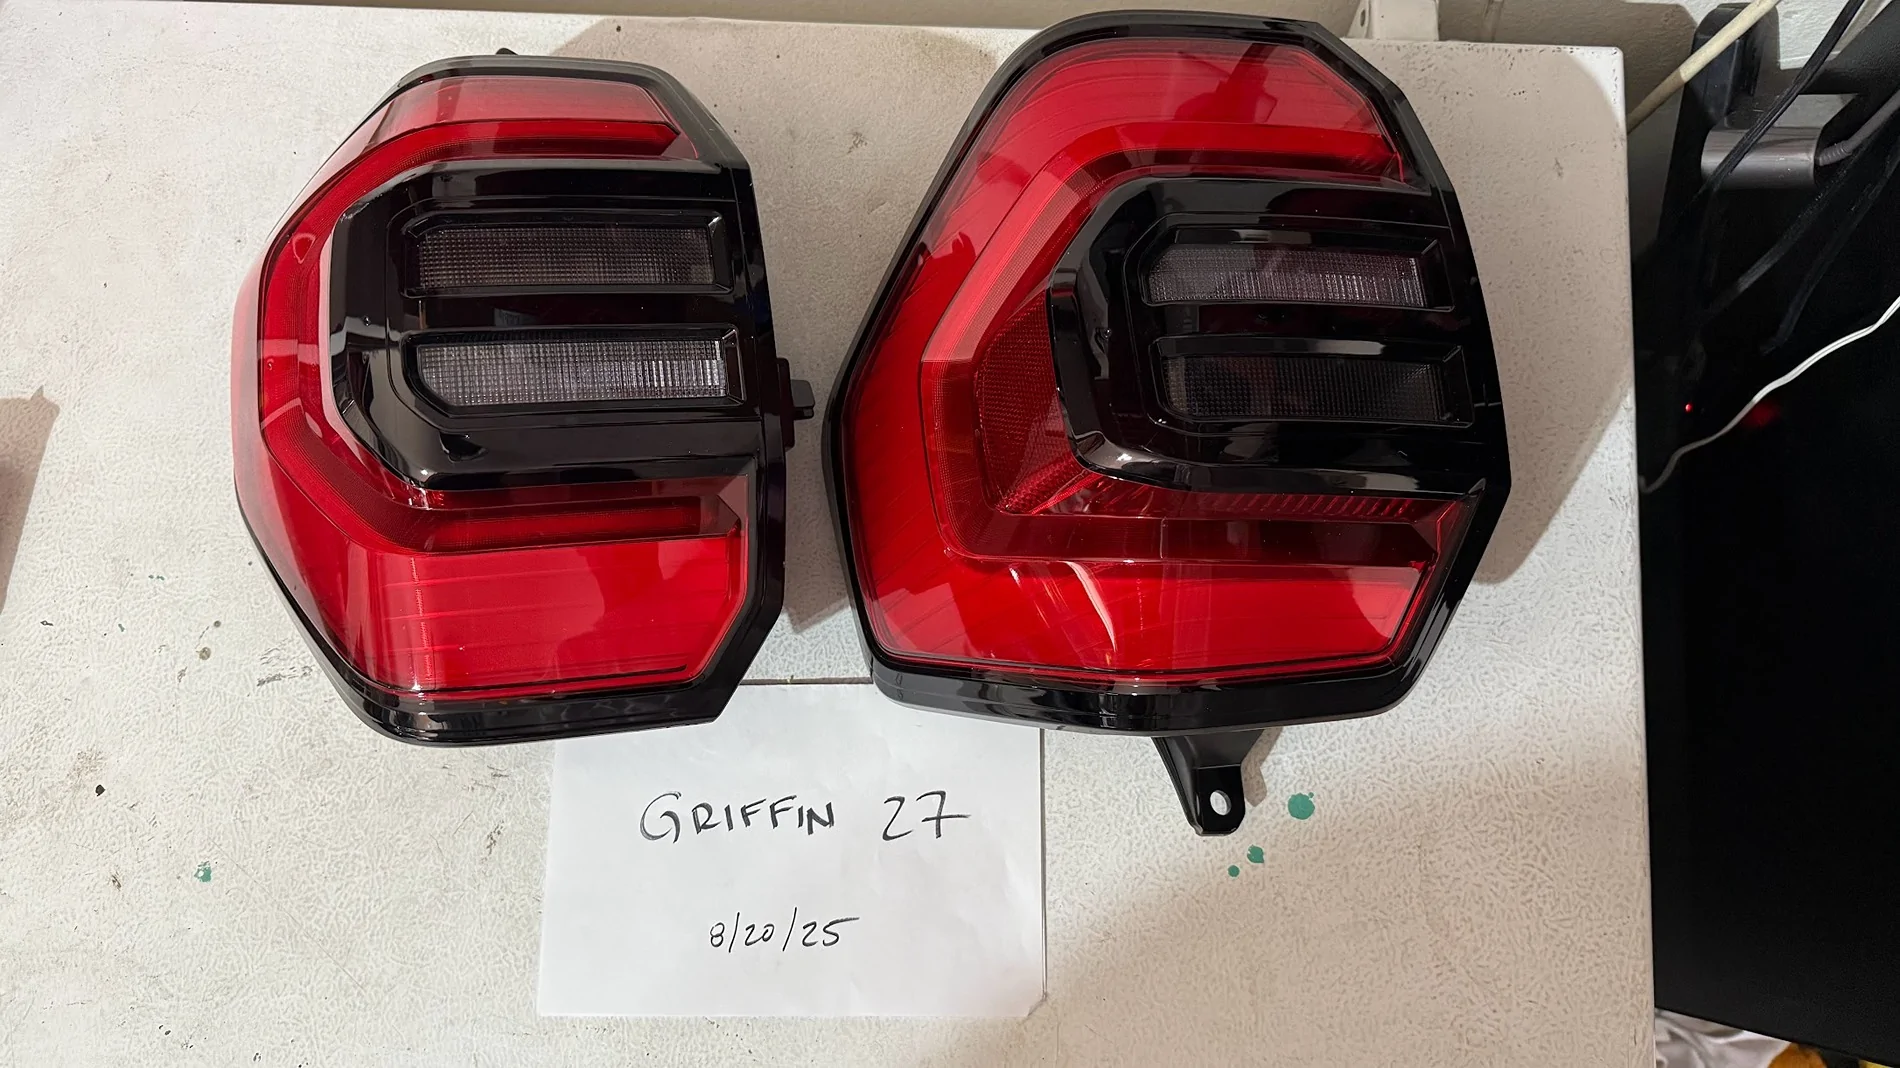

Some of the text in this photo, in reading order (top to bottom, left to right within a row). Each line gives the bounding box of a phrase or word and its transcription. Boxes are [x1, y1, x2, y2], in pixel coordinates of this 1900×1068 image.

[639, 790, 971, 844] GRIFFIN 27
[708, 907, 861, 954] 8/20/25
